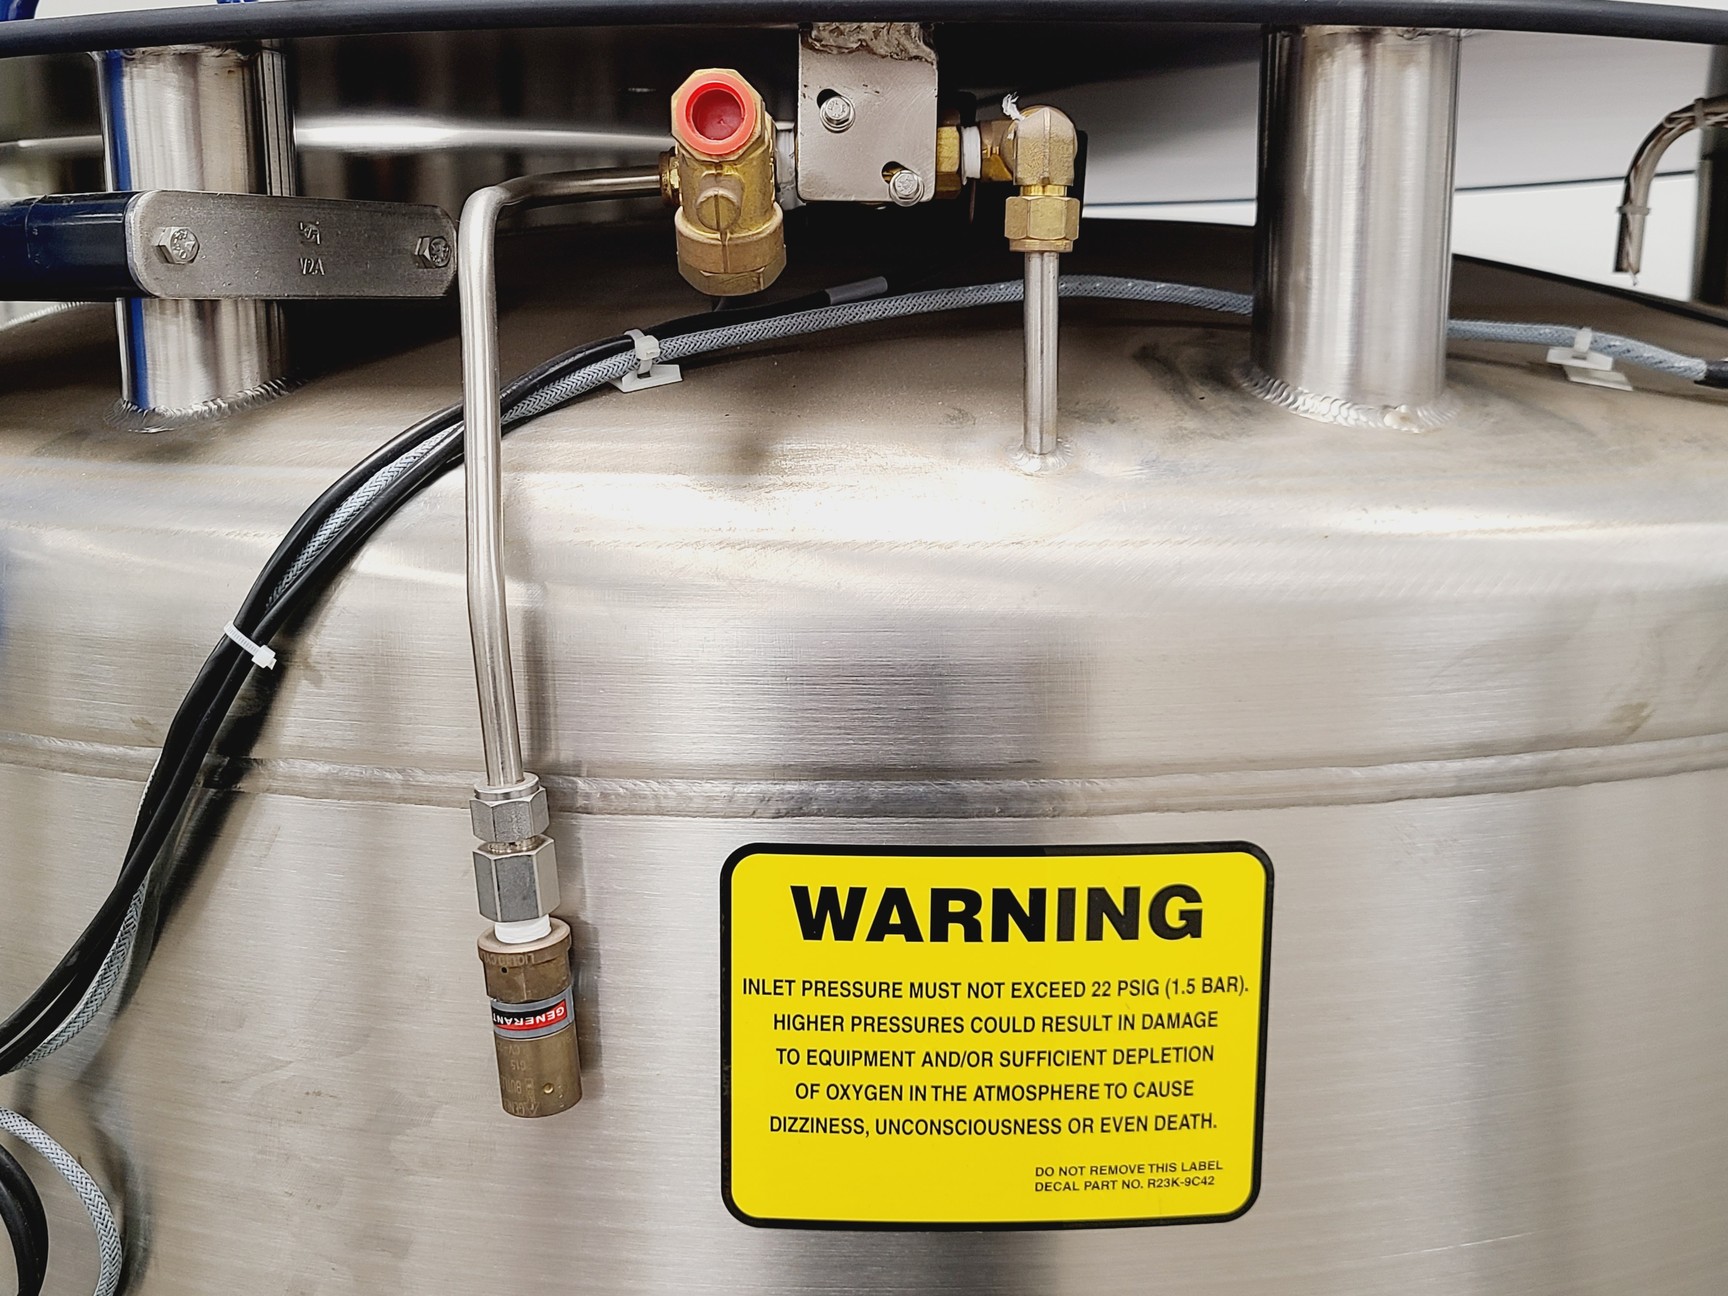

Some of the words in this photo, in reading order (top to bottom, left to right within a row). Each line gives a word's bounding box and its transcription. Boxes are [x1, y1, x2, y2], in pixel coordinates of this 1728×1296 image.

[790, 884, 1202, 942] WARNING
[744, 978, 796, 996] INLET
[802, 980, 902, 998] PRESSURE
[910, 982, 961, 999] MUST
[968, 982, 1005, 999] NOT
[1012, 981, 1085, 998] EXCEED
[1092, 981, 1111, 997] 22
[1118, 979, 1159, 996] PSIG
[1166, 978, 1195, 999] (1.5
[1202, 976, 1248, 996] BAR).
[493, 1005, 565, 1027] GENERANT
[774, 1014, 844, 1032] HIGHER
[852, 1016, 964, 1033] PRESSURES
[971, 1017, 1035, 1033] COULD
[1042, 1015, 1112, 1032] RESULT
[1119, 1014, 1135, 1030] IN
[1142, 1011, 1218, 1030] DAMAGE
[776, 1048, 800, 1065] TO
[807, 1049, 915, 1067] EQUIPMENT
[922, 1051, 993, 1067] AND/OR
[1000, 1049, 1107, 1067] SUFFICIENT
[1113, 1045, 1213, 1065] DEPLETION
[796, 1083, 820, 1099] OF
[827, 1084, 902, 1101] OXYGEN
[910, 1085, 926, 1101] IN
[931, 1085, 966, 1101] THE
[973, 1084, 1099, 1101] ATMOSPHERE
[1104, 1083, 1127, 1099] TO
[1134, 1080, 1193, 1098] CAUSE
[771, 1116, 869, 1137] DIZZINESS,
[876, 1118, 1061, 1135] UNCONSCIOUSNESS
[1068, 1118, 1093, 1134] OR
[1101, 1116, 1147, 1133] EVEN
[1155, 1113, 1216, 1131] DEATH.
[1036, 1167, 1054, 1176] DO
[1059, 1166, 1085, 1176] NOT
[1090, 1164, 1144, 1175] REMOVE
[1148, 1163, 1176, 1173] THIS
[1182, 1161, 1222, 1171] LABEL
[1035, 1182, 1079, 1191] DECAL
[1085, 1180, 1117, 1190] PART
[1122, 1179, 1143, 1189] NO.
[1148, 1176, 1214, 1188] R23K-9C42
